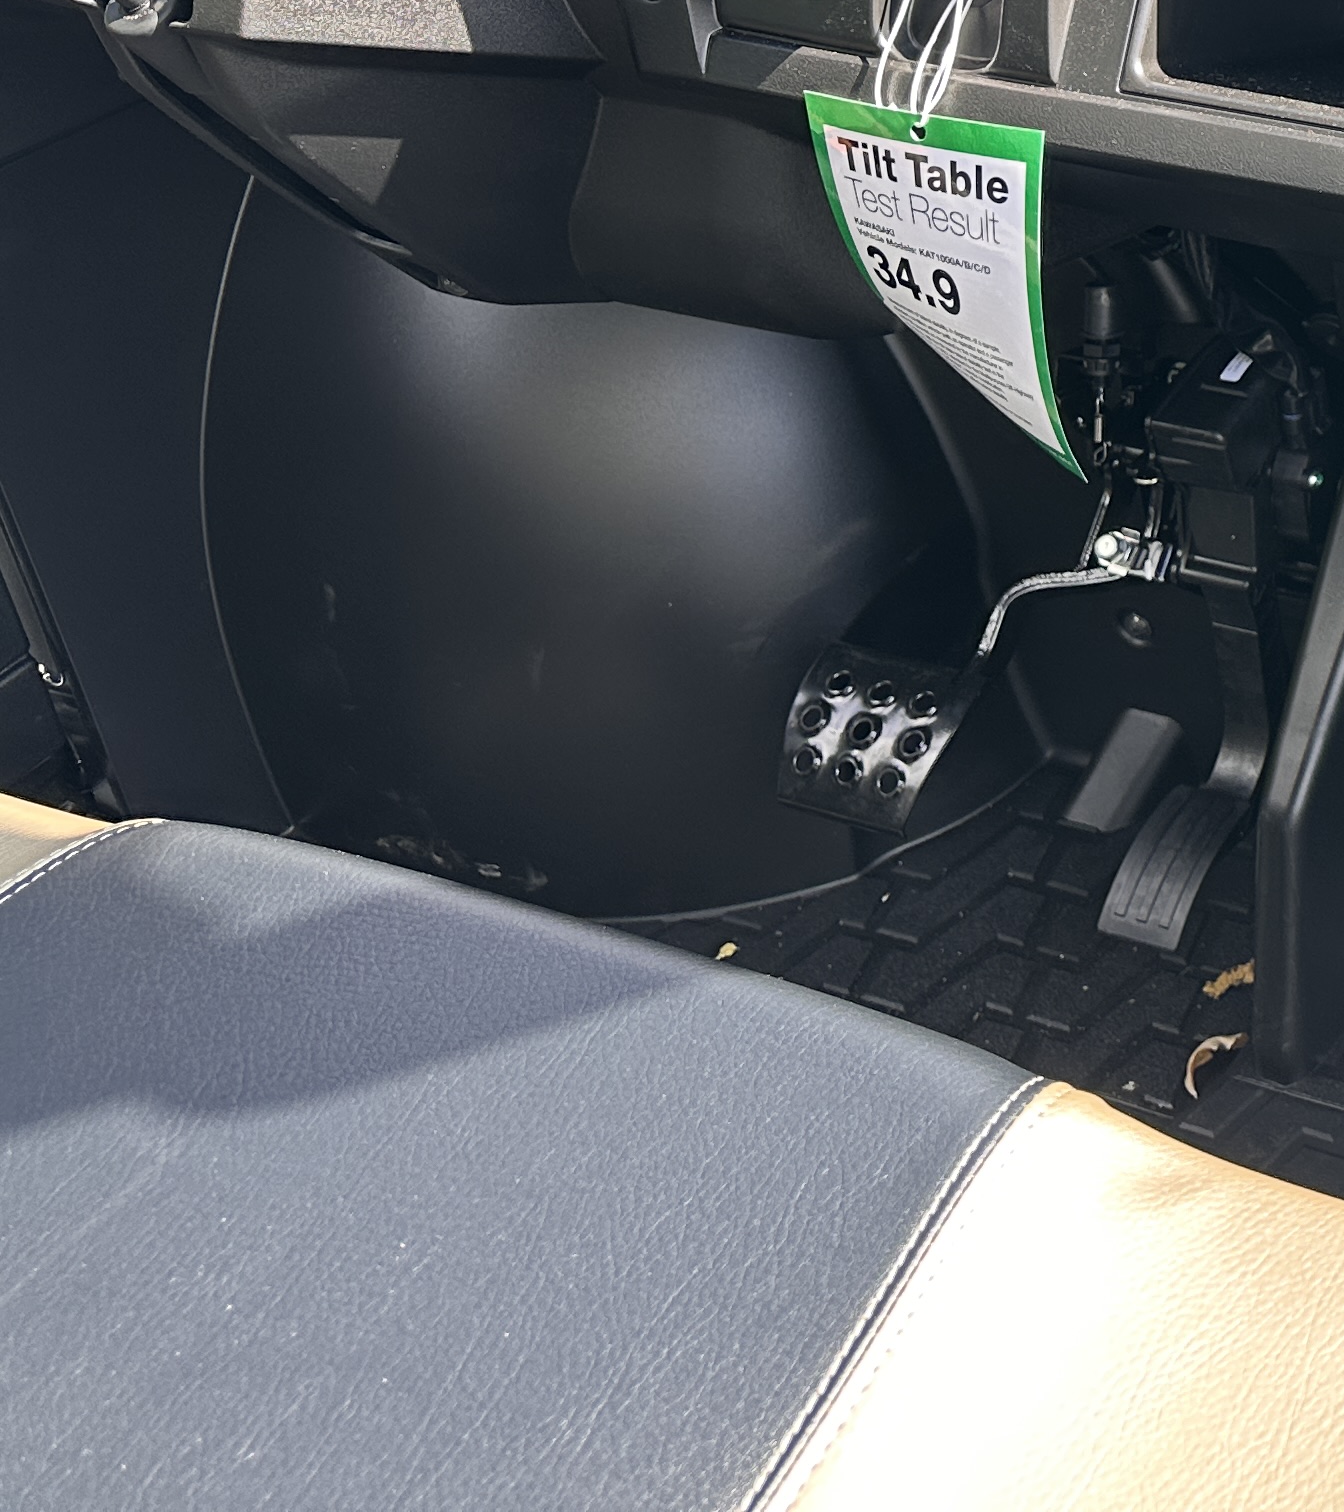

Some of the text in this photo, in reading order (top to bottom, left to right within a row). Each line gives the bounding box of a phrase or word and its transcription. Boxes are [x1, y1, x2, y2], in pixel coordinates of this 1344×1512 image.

[837, 136, 1009, 204] Tilt Table
[844, 175, 1001, 244] Test Result
[867, 245, 960, 315] 34.9
